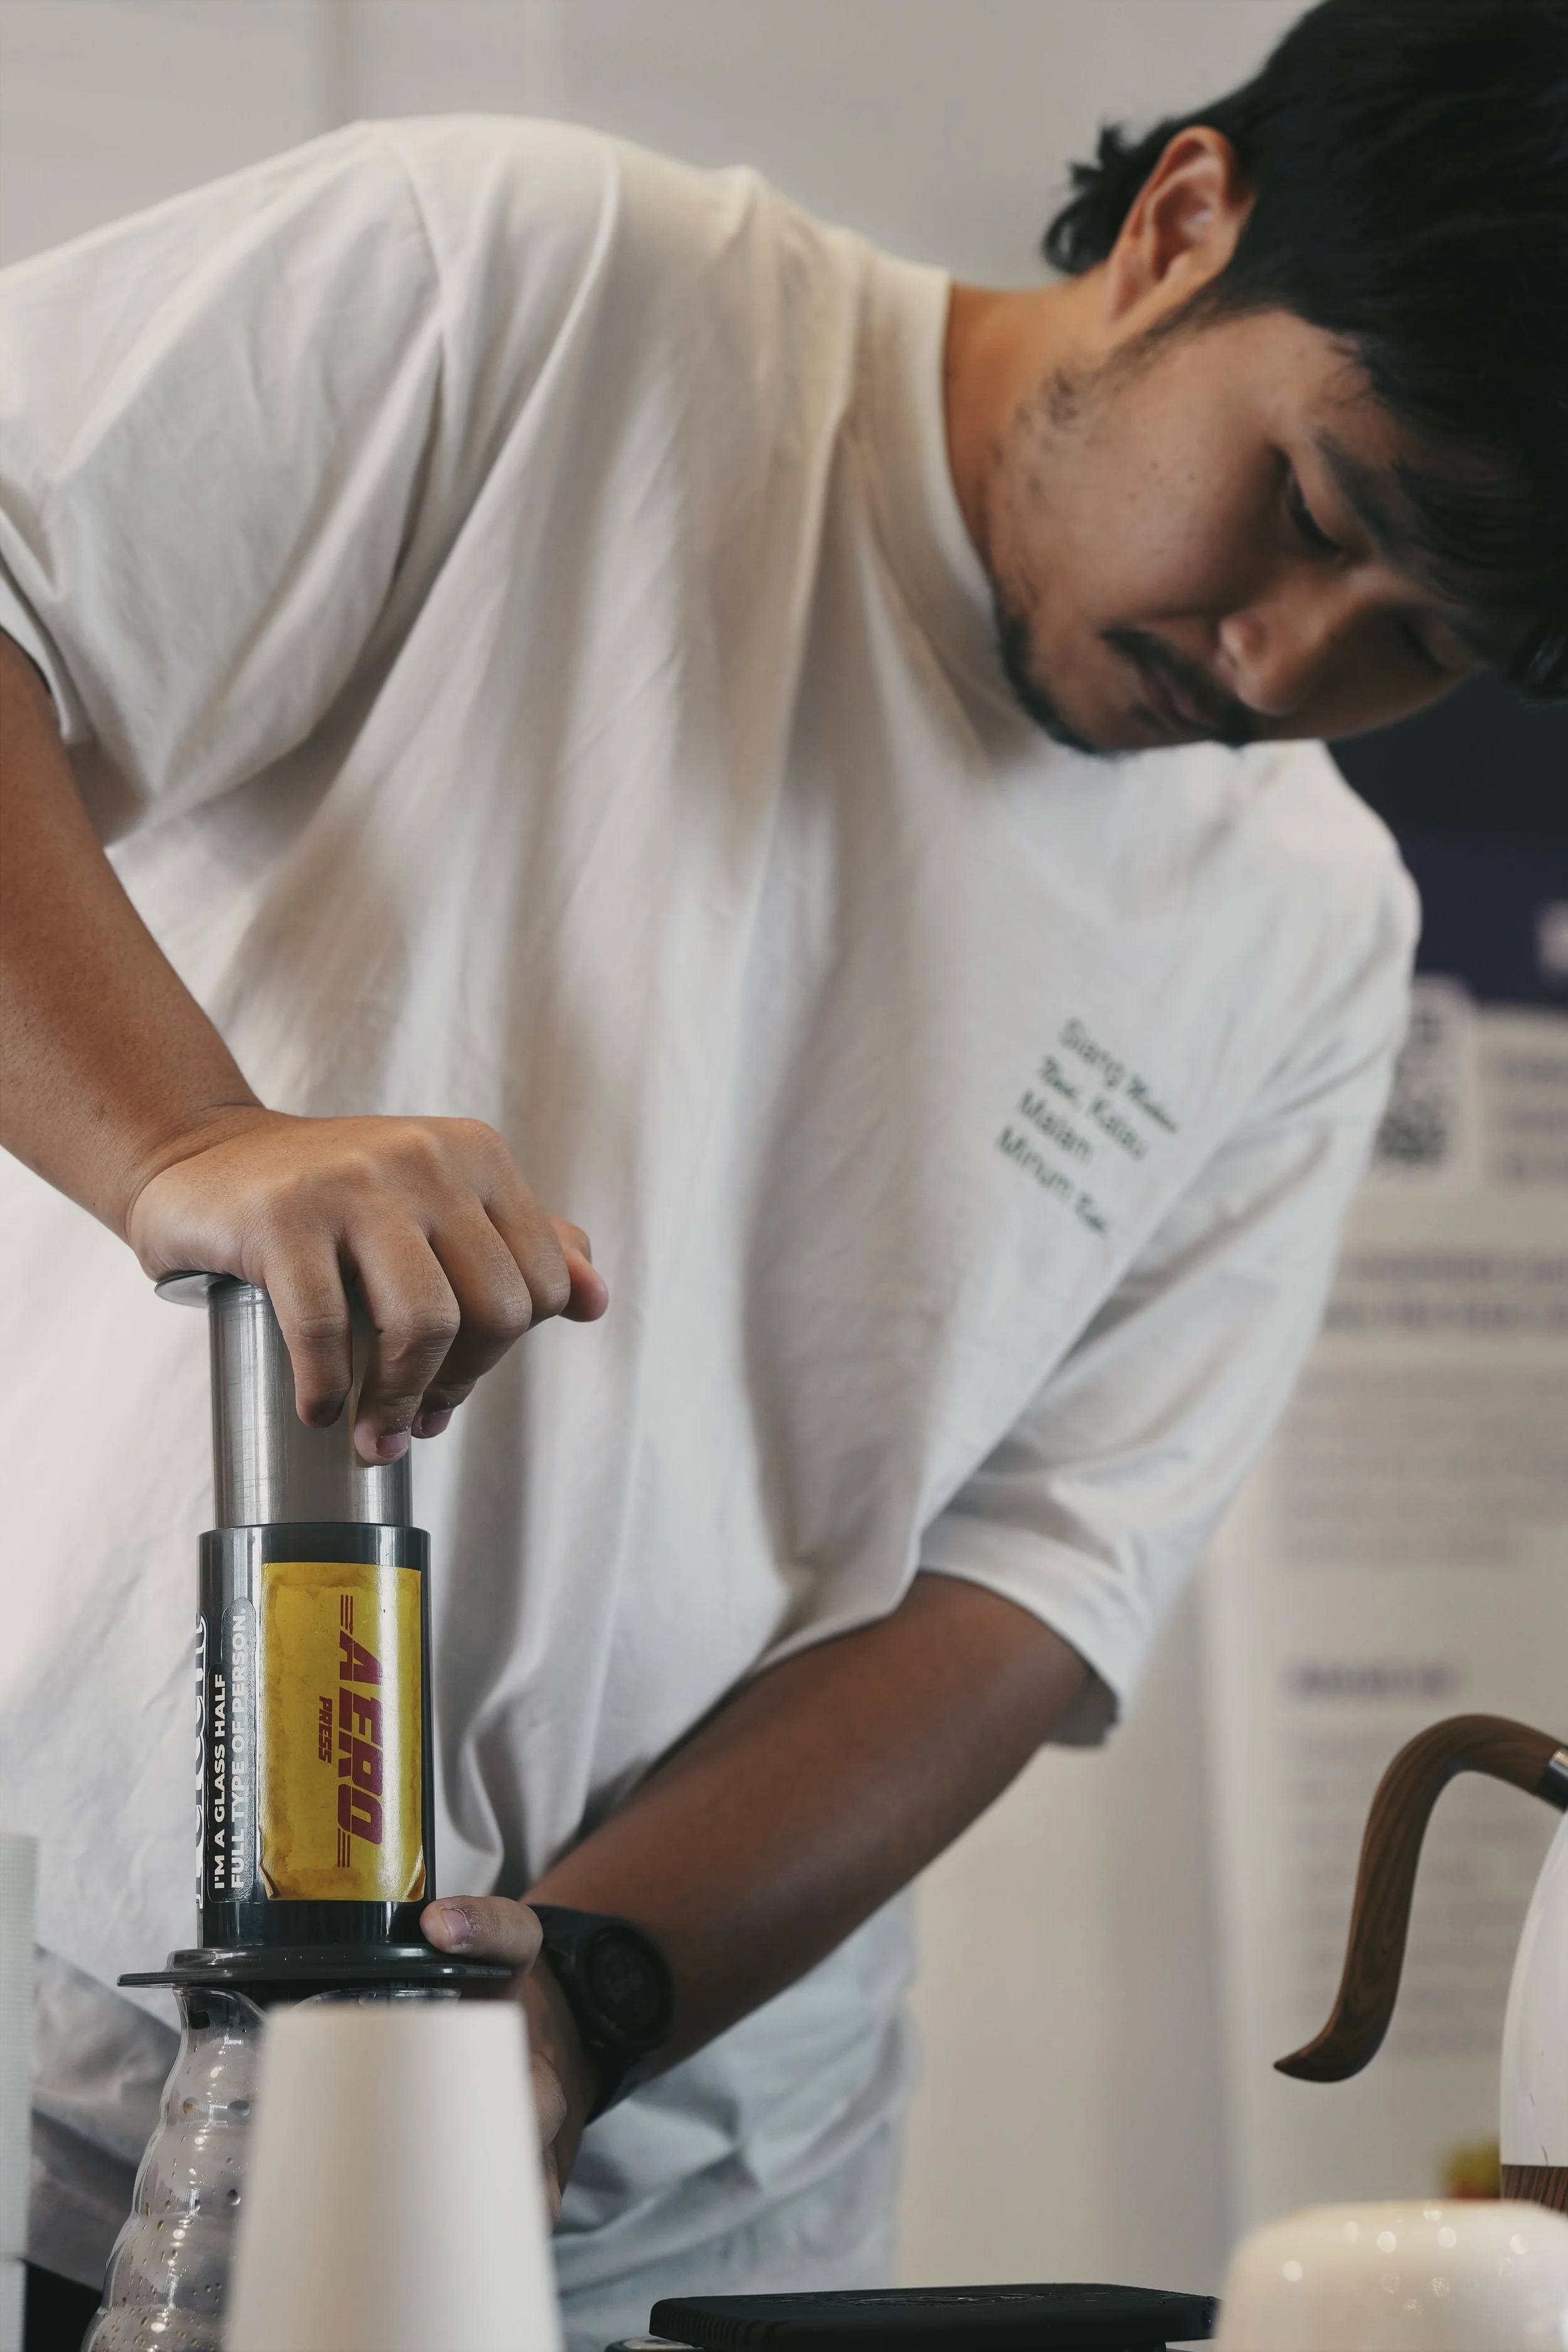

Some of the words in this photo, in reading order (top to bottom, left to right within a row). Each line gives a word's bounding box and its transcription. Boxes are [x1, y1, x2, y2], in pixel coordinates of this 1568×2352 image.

[231, 1607, 246, 1713] PERSON.
[215, 1674, 226, 1737] HALF
[231, 1720, 245, 1753] OF
[318, 1695, 332, 1764] PRESS
[337, 1629, 383, 1845] AERO
[214, 1744, 225, 1823] GLASS
[231, 1760, 245, 1823] TYPE
[214, 1828, 225, 1848] A
[231, 1828, 245, 1889] FULL
[214, 1855, 225, 1889] I'M
